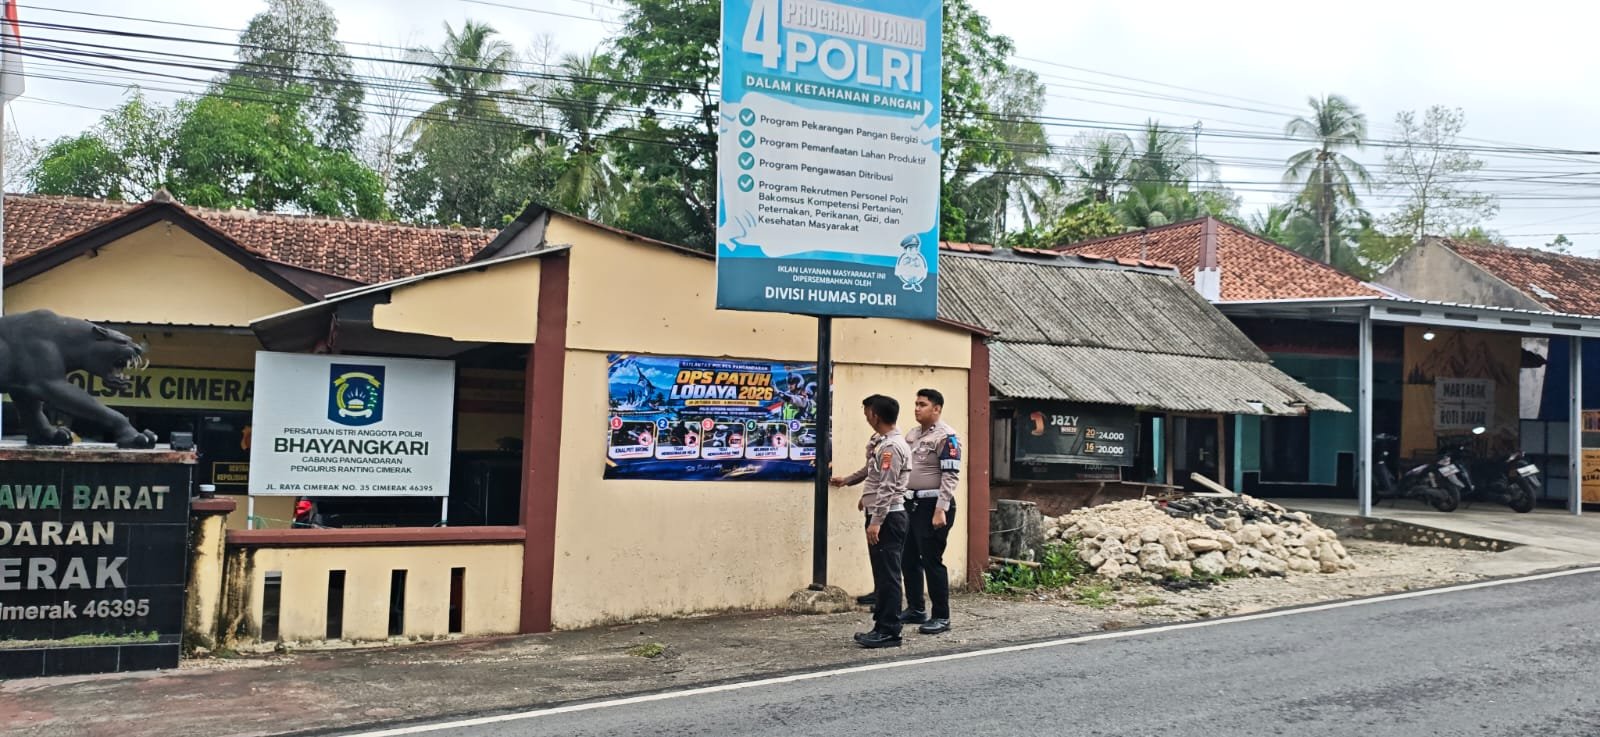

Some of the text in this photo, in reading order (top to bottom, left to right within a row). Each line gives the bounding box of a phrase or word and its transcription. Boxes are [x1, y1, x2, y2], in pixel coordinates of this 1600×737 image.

[785, 3, 924, 48] PROGRAM UTAMA
[742, 0, 921, 92] 4 POLRI
[746, 75, 921, 111] DALAM KETAHANAN PANGAN
[760, 115, 919, 145] Program Pekarangan Pangan Bergizi
[759, 137, 927, 166] Program Pemanfaatan Lahan Produktif
[759, 159, 893, 182] Program Pengawasan Ditribusi
[758, 181, 909, 205] Program Rekrutmen Personel Polri
[758, 193, 904, 216] Bakomsus Kompetensi Pertanian,
[758, 204, 900, 226] Peternakan, Perikanan, Gizi, dan
[758, 215, 860, 233] Kesehatan Masyarakat
[777, 265, 887, 280] IKLAN LAYANAN MASYARAKAT INI
[792, 275, 872, 287] DIPERSEMBAHKAN OLEH
[765, 286, 897, 306] DIVISI HUMAS POLRI
[676, 370, 771, 386] OPS PATUH
[670, 385, 774, 400] LODAYA 2026
[284, 427, 336, 436] PERSATUAN
[335, 429, 357, 437] ISTRI
[357, 430, 398, 438] ANGGOTA
[1099, 431, 1125, 441] 24.000
[274, 438, 429, 456] BHAYANGKARI
[290, 465, 337, 473] PENGURUS
[337, 466, 375, 474] RANTING
[302, 456, 403, 465] CABANG PANGANDARAN
[72, 485, 170, 510] BARAT
[303, 484, 339, 492] CIMERAK
[82, 599, 150, 618] 46395
